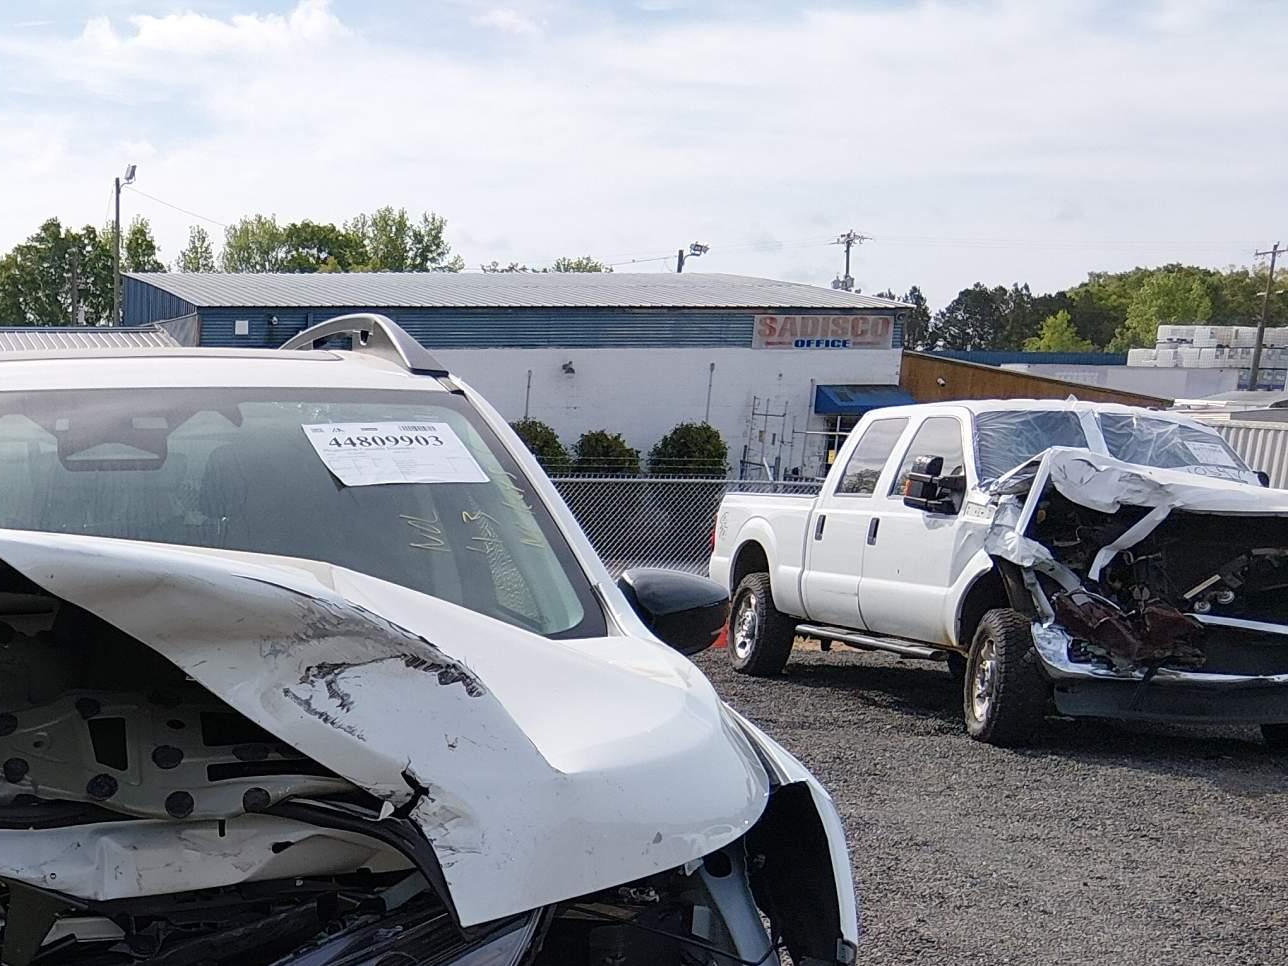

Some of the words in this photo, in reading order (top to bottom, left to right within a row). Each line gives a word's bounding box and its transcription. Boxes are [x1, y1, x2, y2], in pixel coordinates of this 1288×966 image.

[758, 316, 890, 337] SADISCO
[794, 339, 851, 348] OFFICE
[329, 435, 444, 448] 44809903
